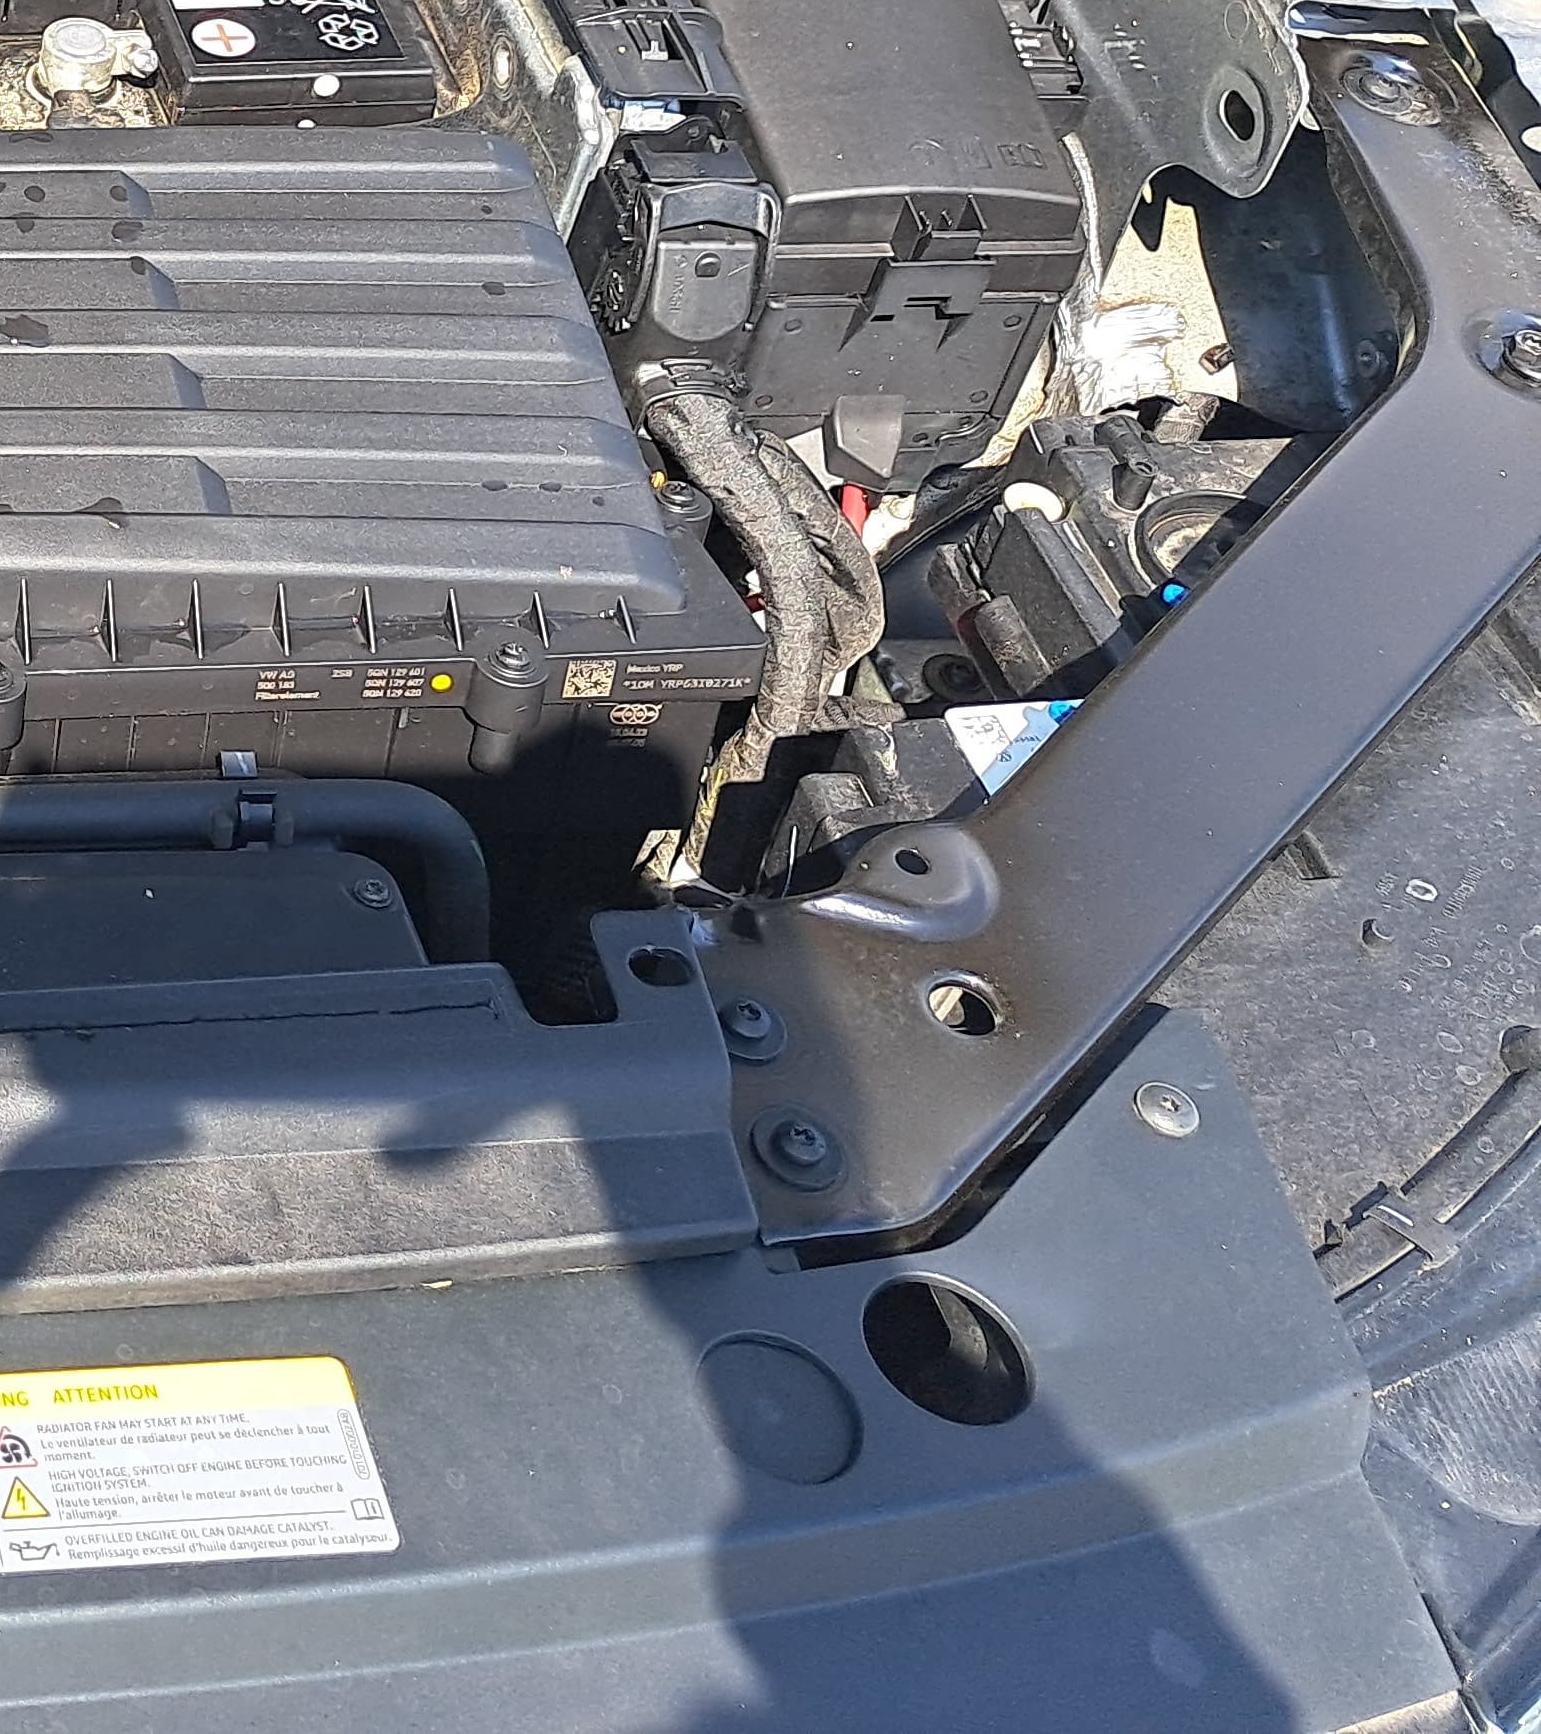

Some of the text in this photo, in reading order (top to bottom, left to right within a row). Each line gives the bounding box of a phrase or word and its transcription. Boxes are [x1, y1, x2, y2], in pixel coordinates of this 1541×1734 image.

[259, 671, 278, 680] VW
[662, 663, 684, 673] YRP
[54, 1384, 159, 1404] ATTENTION
[37, 1421, 92, 1434] RADIATOR
[95, 1421, 116, 1430] FAN
[119, 1419, 141, 1429] MAY
[145, 1417, 177, 1428] START
[180, 1416, 194, 1426] AT
[195, 1415, 217, 1425] ANY
[57, 1436, 117, 1449] ventilateur
[121, 1435, 134, 1445] de
[137, 1432, 187, 1443] radiateur
[191, 1430, 216, 1443] peut
[219, 1429, 231, 1439] se
[297, 1424, 304, 1435] à
[306, 1425, 330, 1434] tout
[44, 1452, 95, 1462] moment.
[48, 1470, 77, 1480] HIGH
[133, 1463, 175, 1476] SWITCH
[178, 1462, 198, 1473] OFF
[202, 1460, 242, 1472] ENGINE
[245, 1458, 288, 1470] BEFORE
[290, 1455, 347, 1466] TOUCHING
[52, 1479, 150, 1493] IGNITION SYSTEM.
[56, 1481, 344, 1509] Haute tension, arrêter le moteur avant de toucher à
[65, 1521, 333, 1546] OVERFILLED ENGINE OIL CAN DAMAGE CATALYST.
[68, 1534, 392, 1560] Remplissage excessif d'huile dangereux pour le catalyseur.
